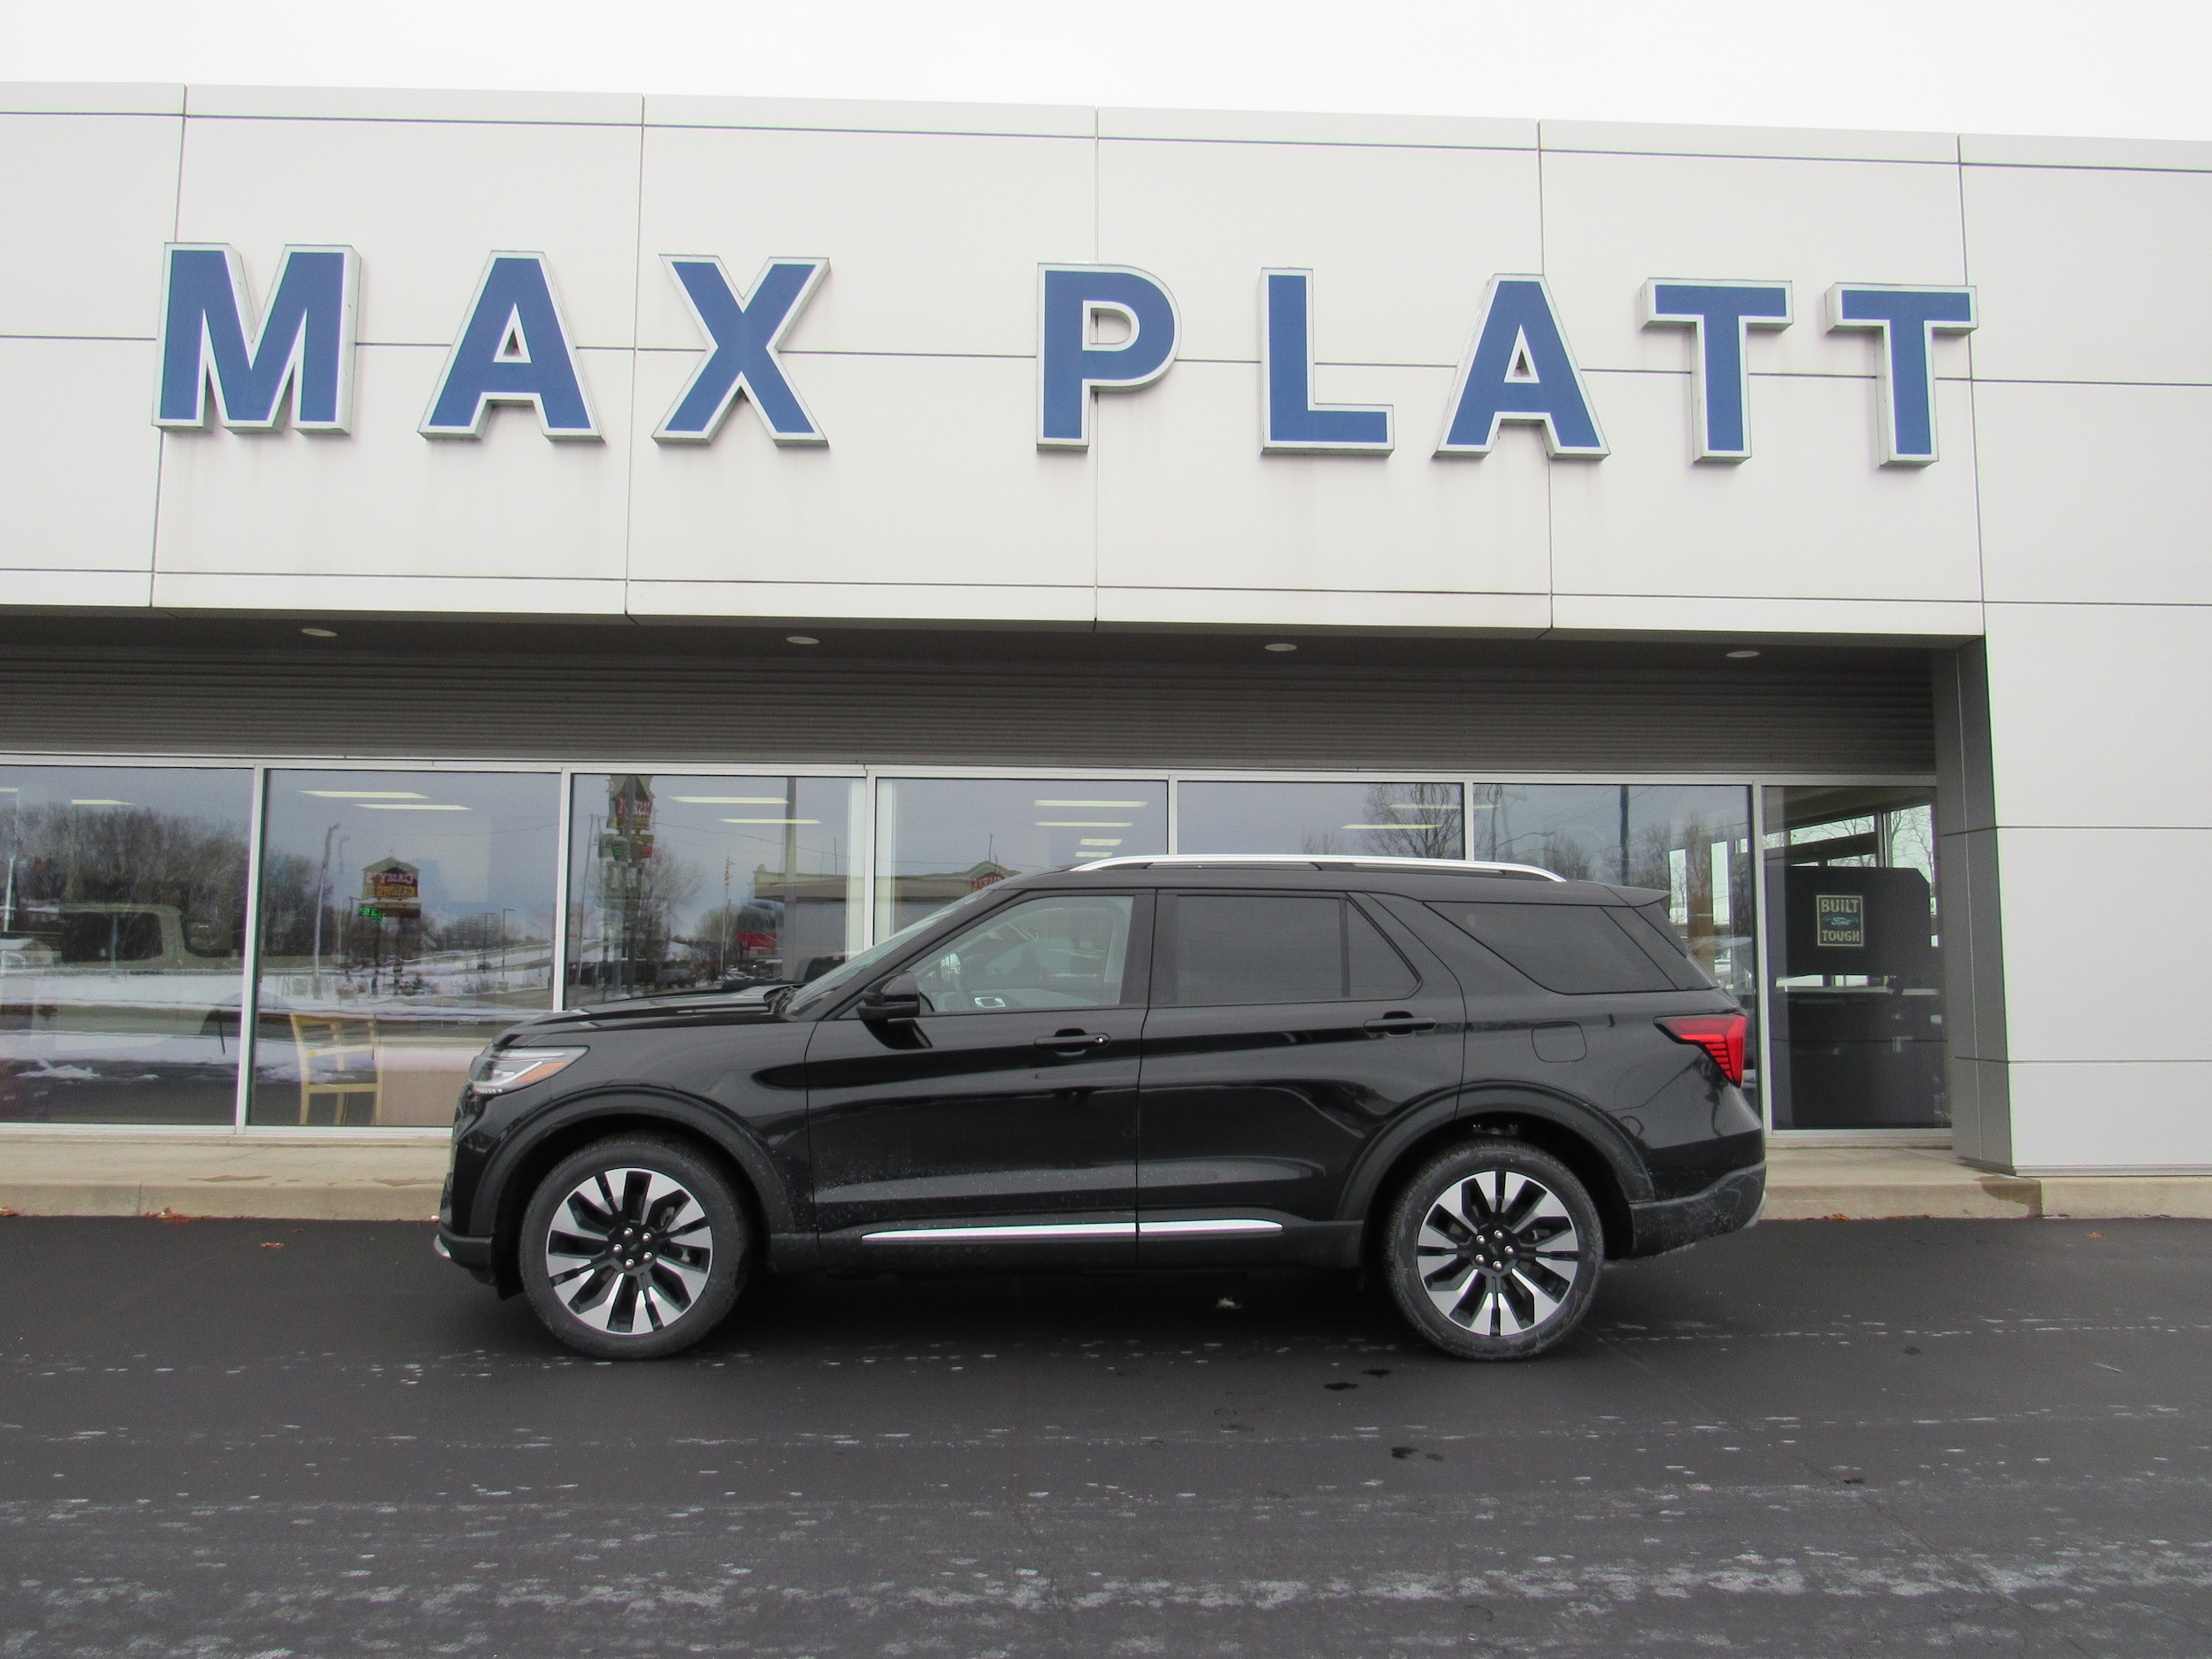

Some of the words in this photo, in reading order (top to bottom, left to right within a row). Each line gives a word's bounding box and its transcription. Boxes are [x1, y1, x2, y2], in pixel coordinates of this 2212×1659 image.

[151, 242, 831, 448] MAX
[1036, 263, 1978, 467] PLATT
[1821, 898, 1859, 913] BUILT
[1822, 930, 1860, 942] TOUGH
